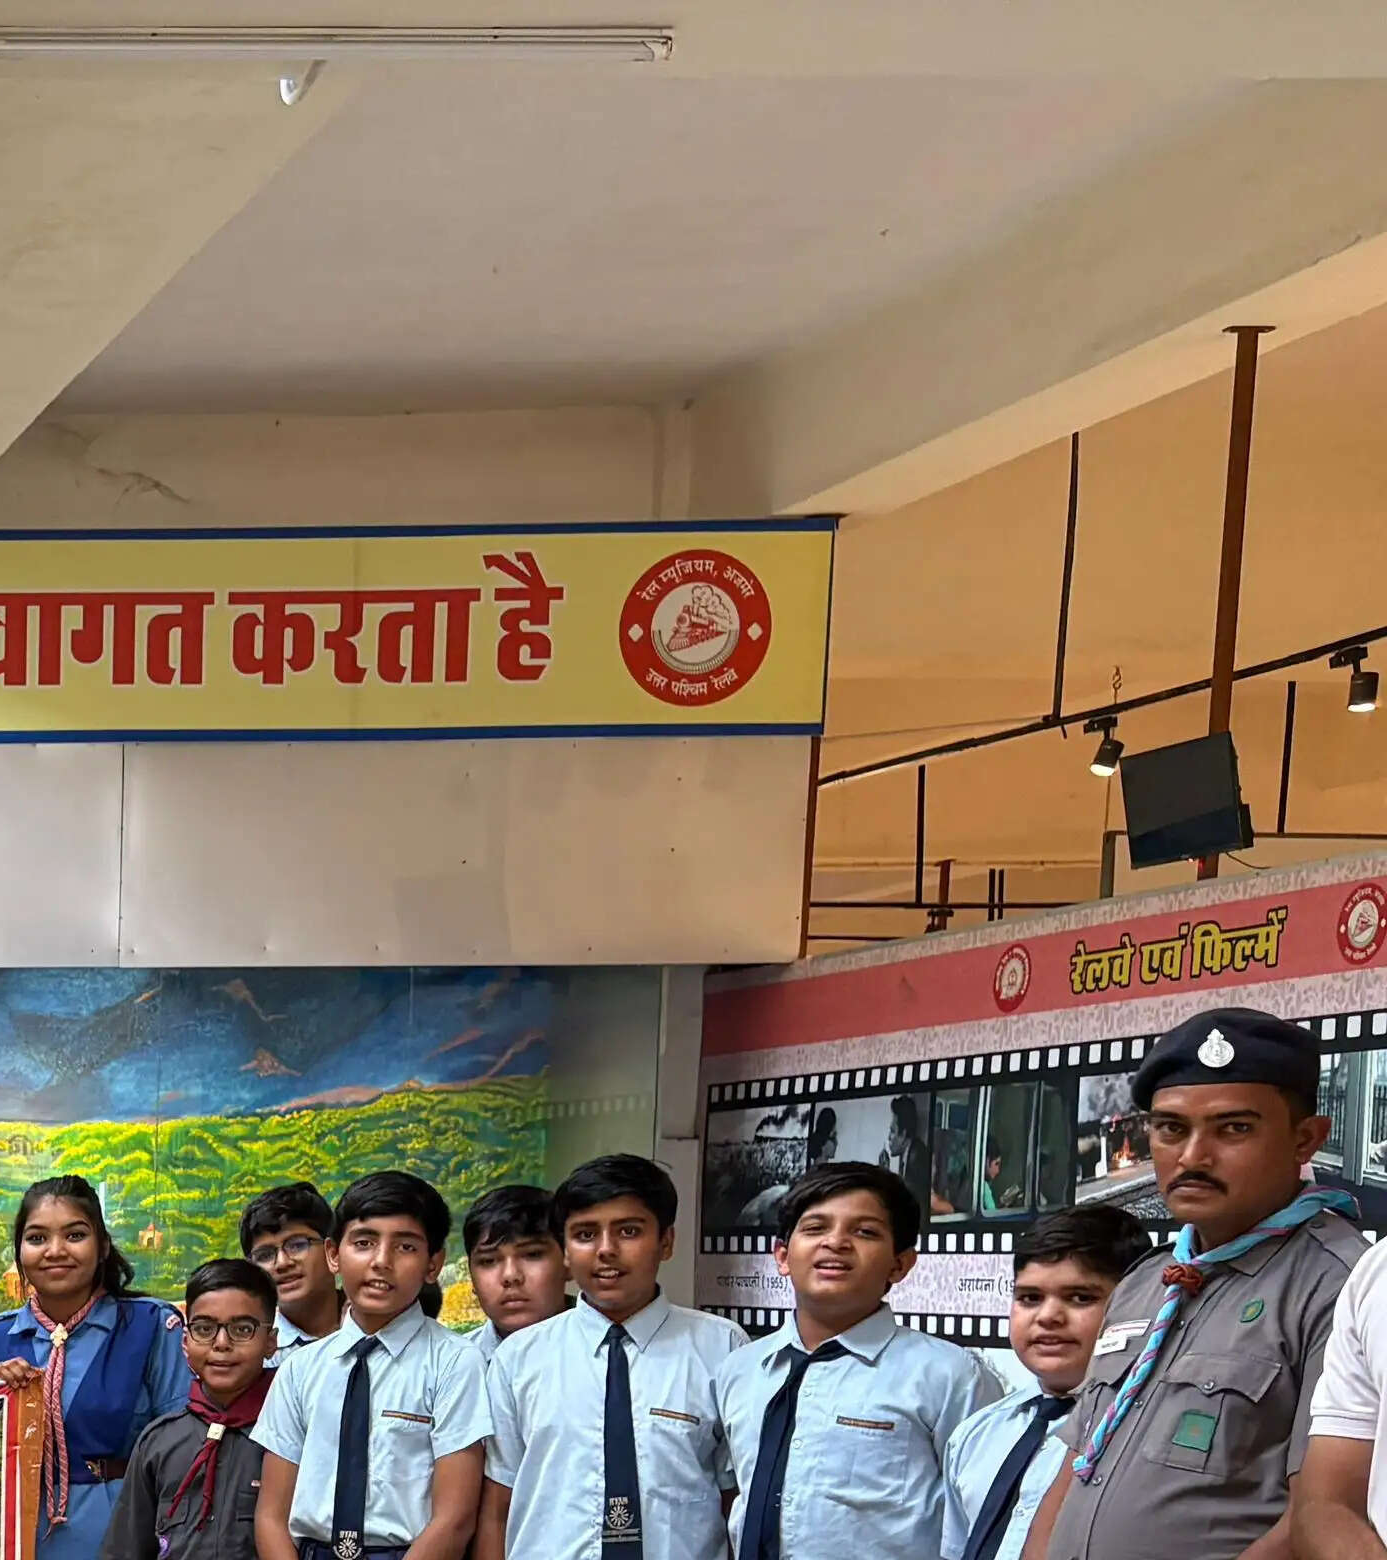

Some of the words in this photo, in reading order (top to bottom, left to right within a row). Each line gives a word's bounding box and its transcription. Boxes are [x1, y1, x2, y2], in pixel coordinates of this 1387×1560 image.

[228, 587, 481, 685] करता
[483, 551, 564, 681] है
[1070, 933, 1136, 994] रेलवे
[1140, 922, 1190, 985] एवं
[1190, 905, 1288, 979] फिल्में
[998, 1275, 1015, 1296] (19
